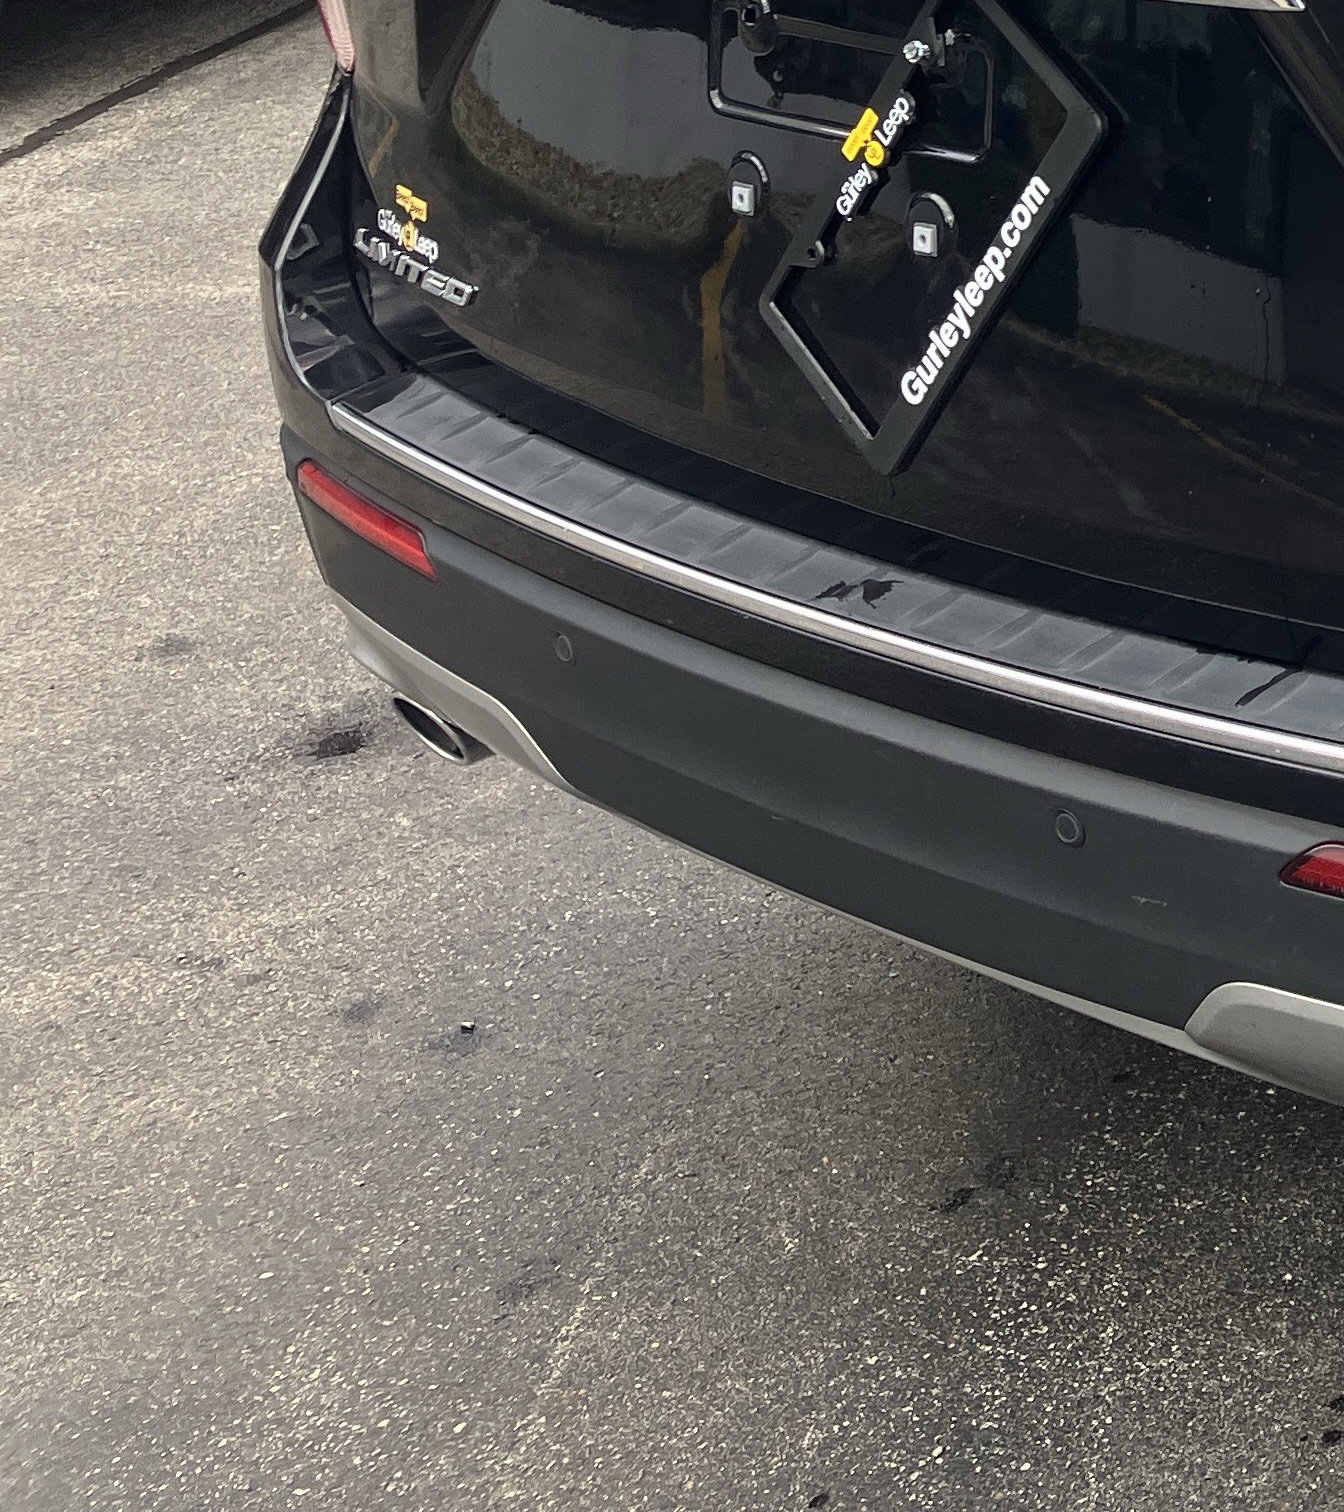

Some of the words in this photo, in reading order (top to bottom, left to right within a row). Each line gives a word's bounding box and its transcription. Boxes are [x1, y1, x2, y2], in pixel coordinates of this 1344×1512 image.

[874, 96, 910, 147] Leep
[353, 227, 480, 307] LIMITED
[900, 175, 1051, 406] Gurleyleep.com
